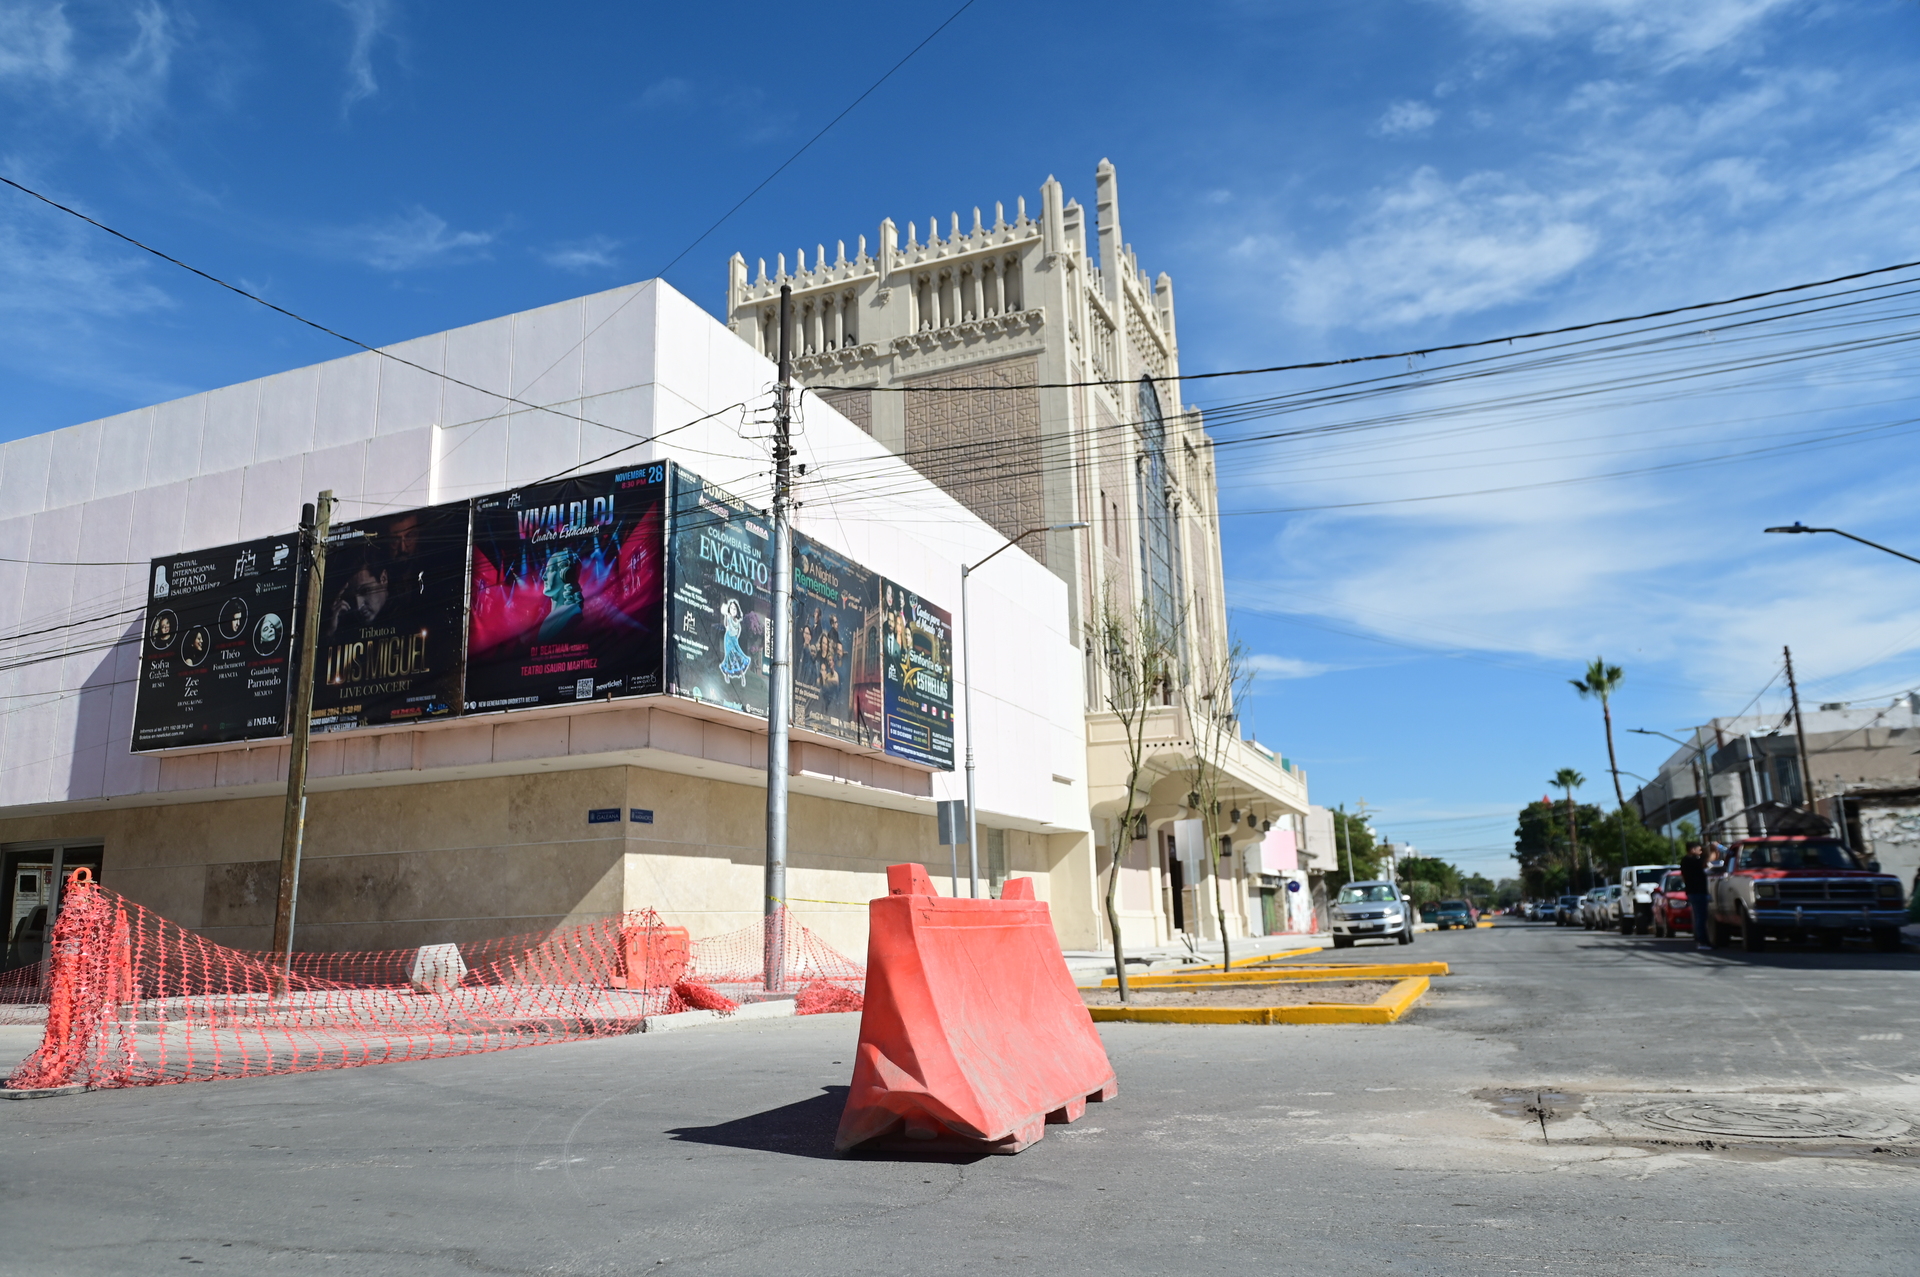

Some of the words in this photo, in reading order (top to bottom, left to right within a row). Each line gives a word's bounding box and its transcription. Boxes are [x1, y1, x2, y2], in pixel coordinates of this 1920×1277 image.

[615, 469, 646, 483] NOVIEMBRE
[648, 465, 664, 484] 28
[621, 480, 635, 489] 8:30
[636, 478, 647, 487] PM
[517, 498, 587, 540] VIVALDI
[593, 494, 615, 526] DJ
[531, 528, 557, 545] Cuatro
[559, 523, 600, 539] Estaciones
[707, 526, 743, 551] COLOMBIA
[743, 544, 752, 554] ES
[751, 548, 762, 559] UN
[173, 559, 198, 570] FESTIVAL
[700, 534, 769, 585] ENCANTO
[172, 563, 216, 578] INTERNACIONAL
[809, 562, 815, 574] A
[815, 565, 832, 583] Night
[832, 575, 839, 588] to
[171, 578, 180, 586] DE
[179, 573, 207, 587] PIANO
[715, 567, 753, 596] MÁGICO
[794, 566, 839, 601] Remember
[170, 587, 191, 597] ISAURO
[916, 604, 930, 621] Cantos
[359, 627, 388, 639] Tributo
[390, 626, 396, 634] a
[220, 650, 241, 660] Théo
[530, 646, 538, 657] DJ
[540, 643, 569, 656] BEATMAN
[151, 660, 170, 671] Sofya
[326, 641, 364, 686] LUIS
[365, 633, 430, 681] MIGUEL
[250, 666, 280, 677] Guadalupe
[520, 665, 543, 677] TEATRO
[543, 661, 566, 674] ISAURO
[566, 657, 598, 672] MARTÍNEZ
[934, 661, 943, 674] de
[218, 671, 239, 679] FRANCIA
[185, 677, 200, 687] Zee
[247, 676, 282, 689] Parrondo
[595, 679, 623, 692] newticket
[916, 671, 948, 700] ESTRELLAS
[184, 687, 199, 698] Zee
[339, 685, 362, 699] LIVE
[363, 679, 413, 696] CONCERT
[486, 698, 508, 707] GENERATION
[897, 695, 920, 708] CONCIERTO
[253, 716, 277, 727] INBAL
